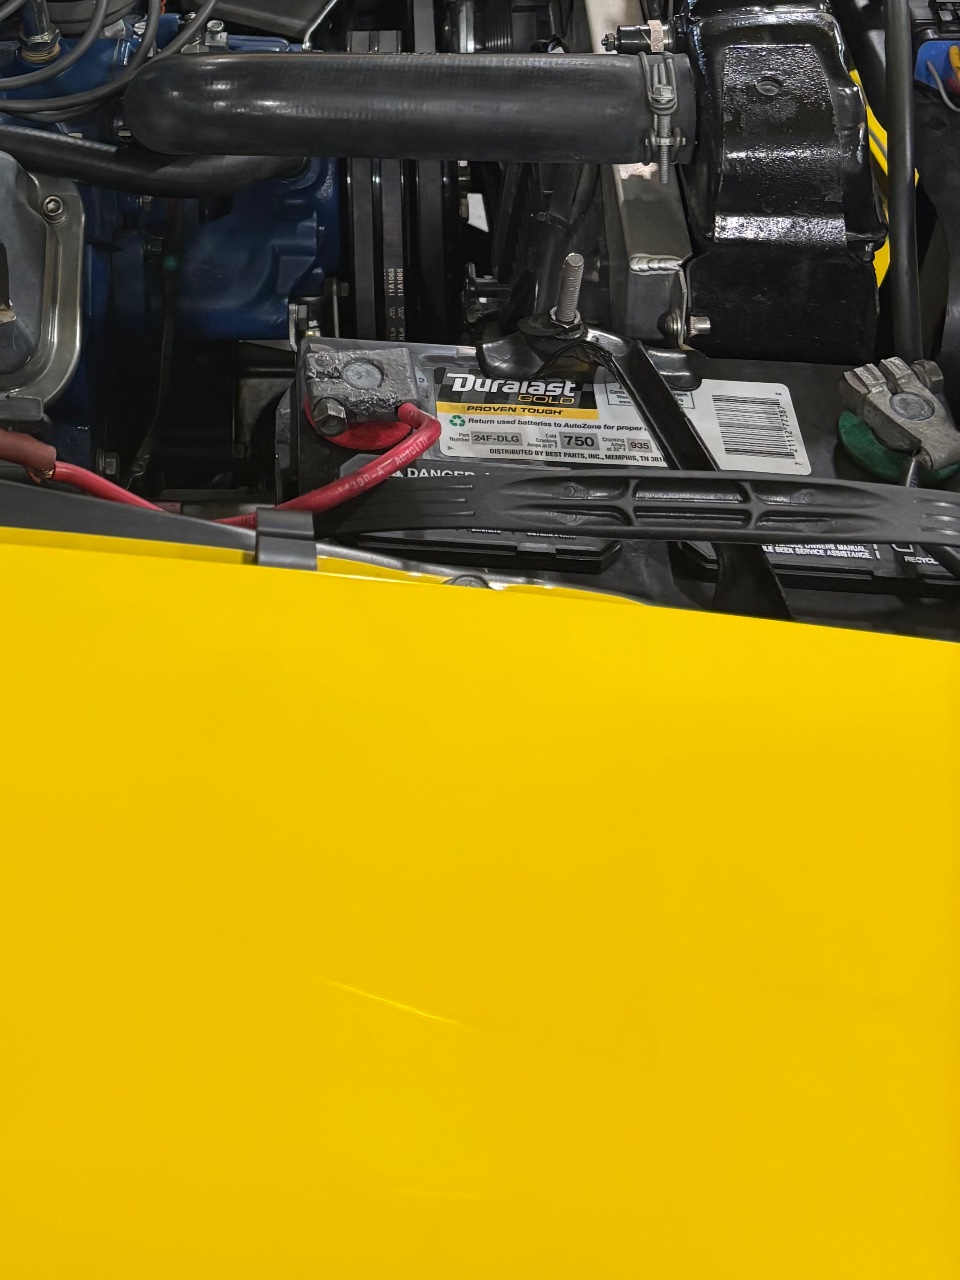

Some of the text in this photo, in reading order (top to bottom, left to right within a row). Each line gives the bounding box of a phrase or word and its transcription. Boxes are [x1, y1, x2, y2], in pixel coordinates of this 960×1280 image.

[446, 373, 577, 397] Duralast
[517, 394, 575, 405] GOLD
[466, 405, 562, 415] PROVEN TOUGH
[468, 417, 495, 425] Return
[517, 419, 552, 428] batteries
[563, 422, 602, 430] AutoZone
[473, 434, 520, 443] 24F-DLG
[563, 435, 595, 447] 750
[489, 448, 533, 456] DISTRIBUTED
[563, 452, 587, 460] PARTS,
[795, 548, 825, 556] SERVICE
